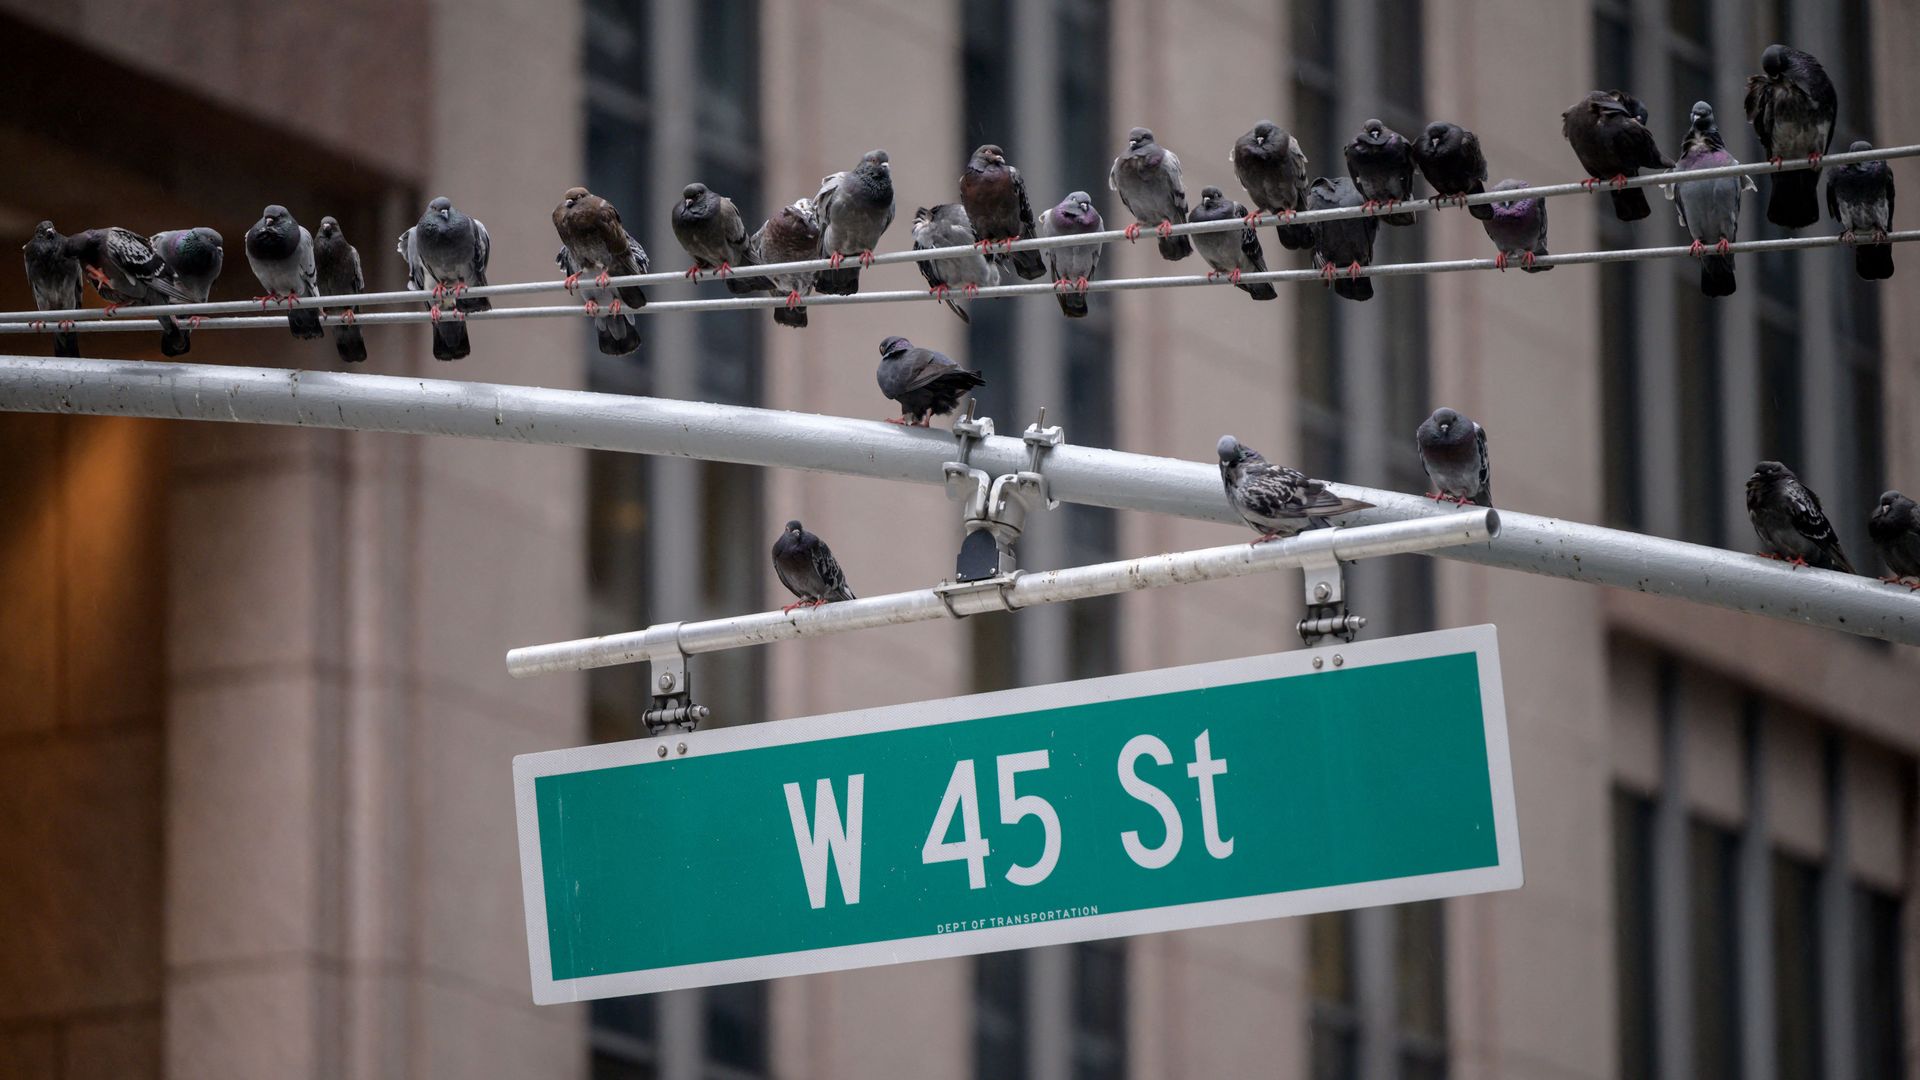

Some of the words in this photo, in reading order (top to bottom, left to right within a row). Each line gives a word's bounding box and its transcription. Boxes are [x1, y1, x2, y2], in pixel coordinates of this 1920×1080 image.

[783, 773, 865, 910] W
[921, 749, 1062, 890] 45
[1117, 729, 1235, 870] St
[937, 920, 967, 934] DEPT
[971, 919, 986, 930] OF
[990, 905, 1099, 927] TRANSPORTATION
